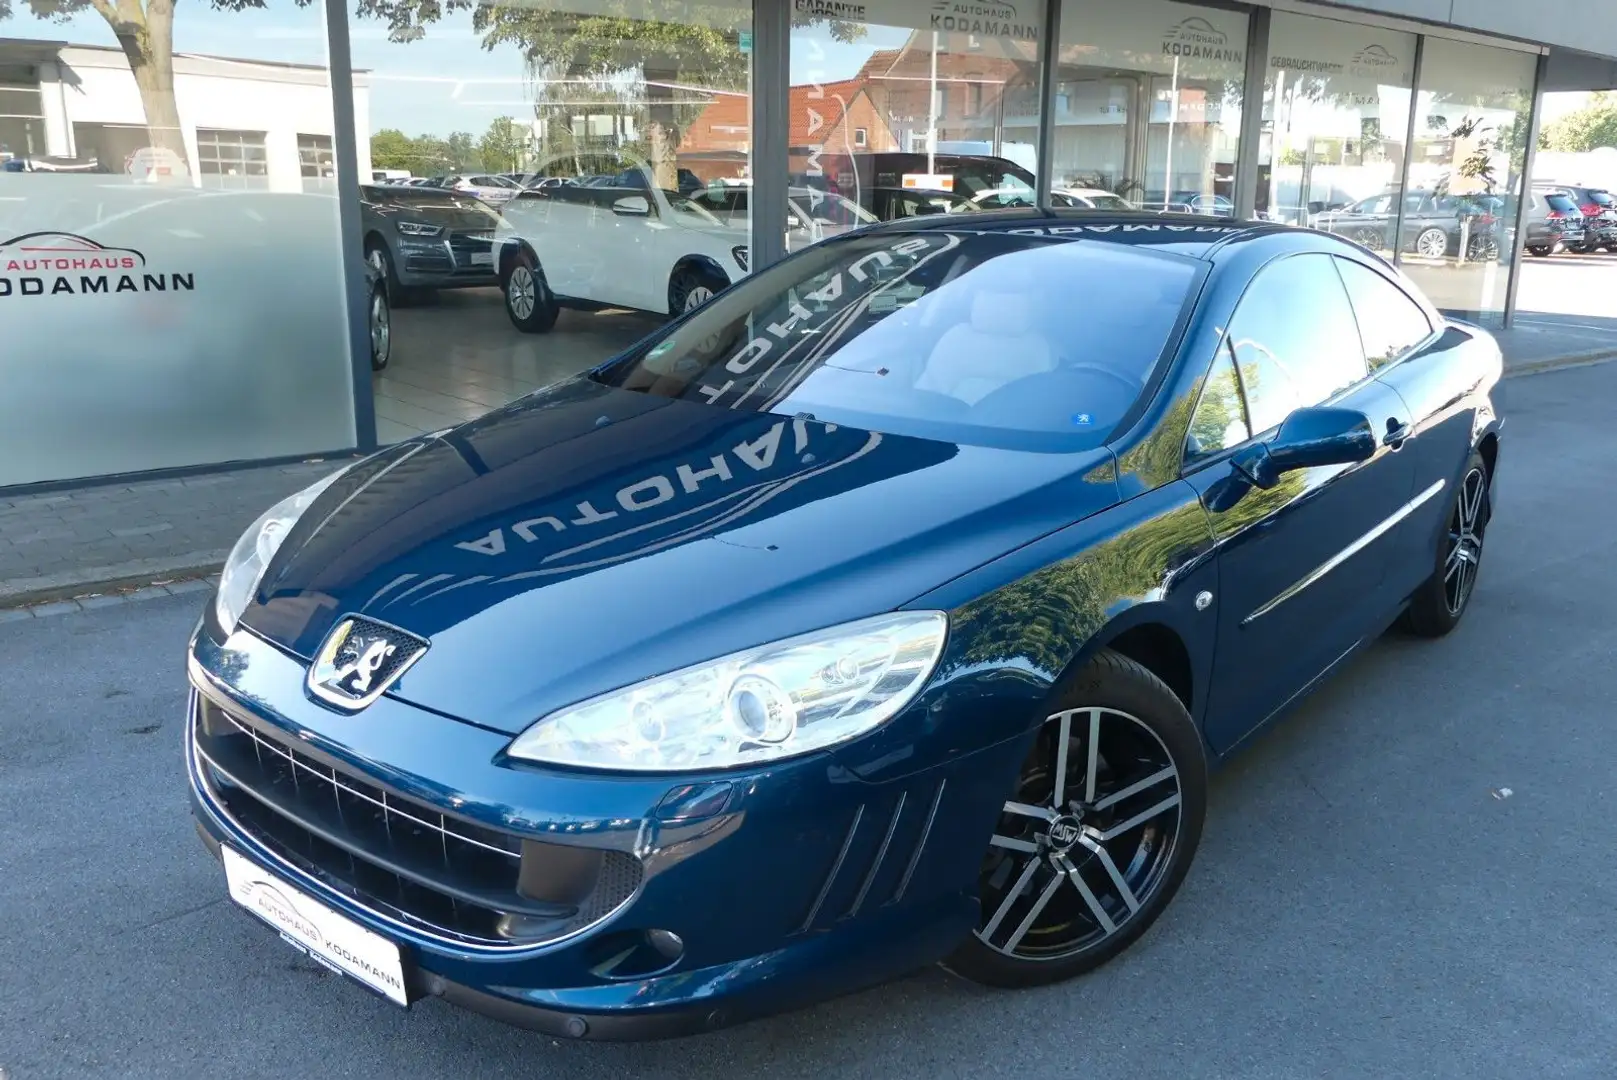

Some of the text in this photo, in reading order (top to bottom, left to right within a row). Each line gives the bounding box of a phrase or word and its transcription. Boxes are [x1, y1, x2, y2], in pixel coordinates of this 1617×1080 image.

[953, 4, 1012, 19] AUTOHAUS
[930, 13, 1038, 40] KODAMANN
[1162, 41, 1242, 64] KODAMANN
[6, 257, 135, 271] AUTOHAUS
[258, 897, 402, 991] AUTOHAUS KODAMANN
